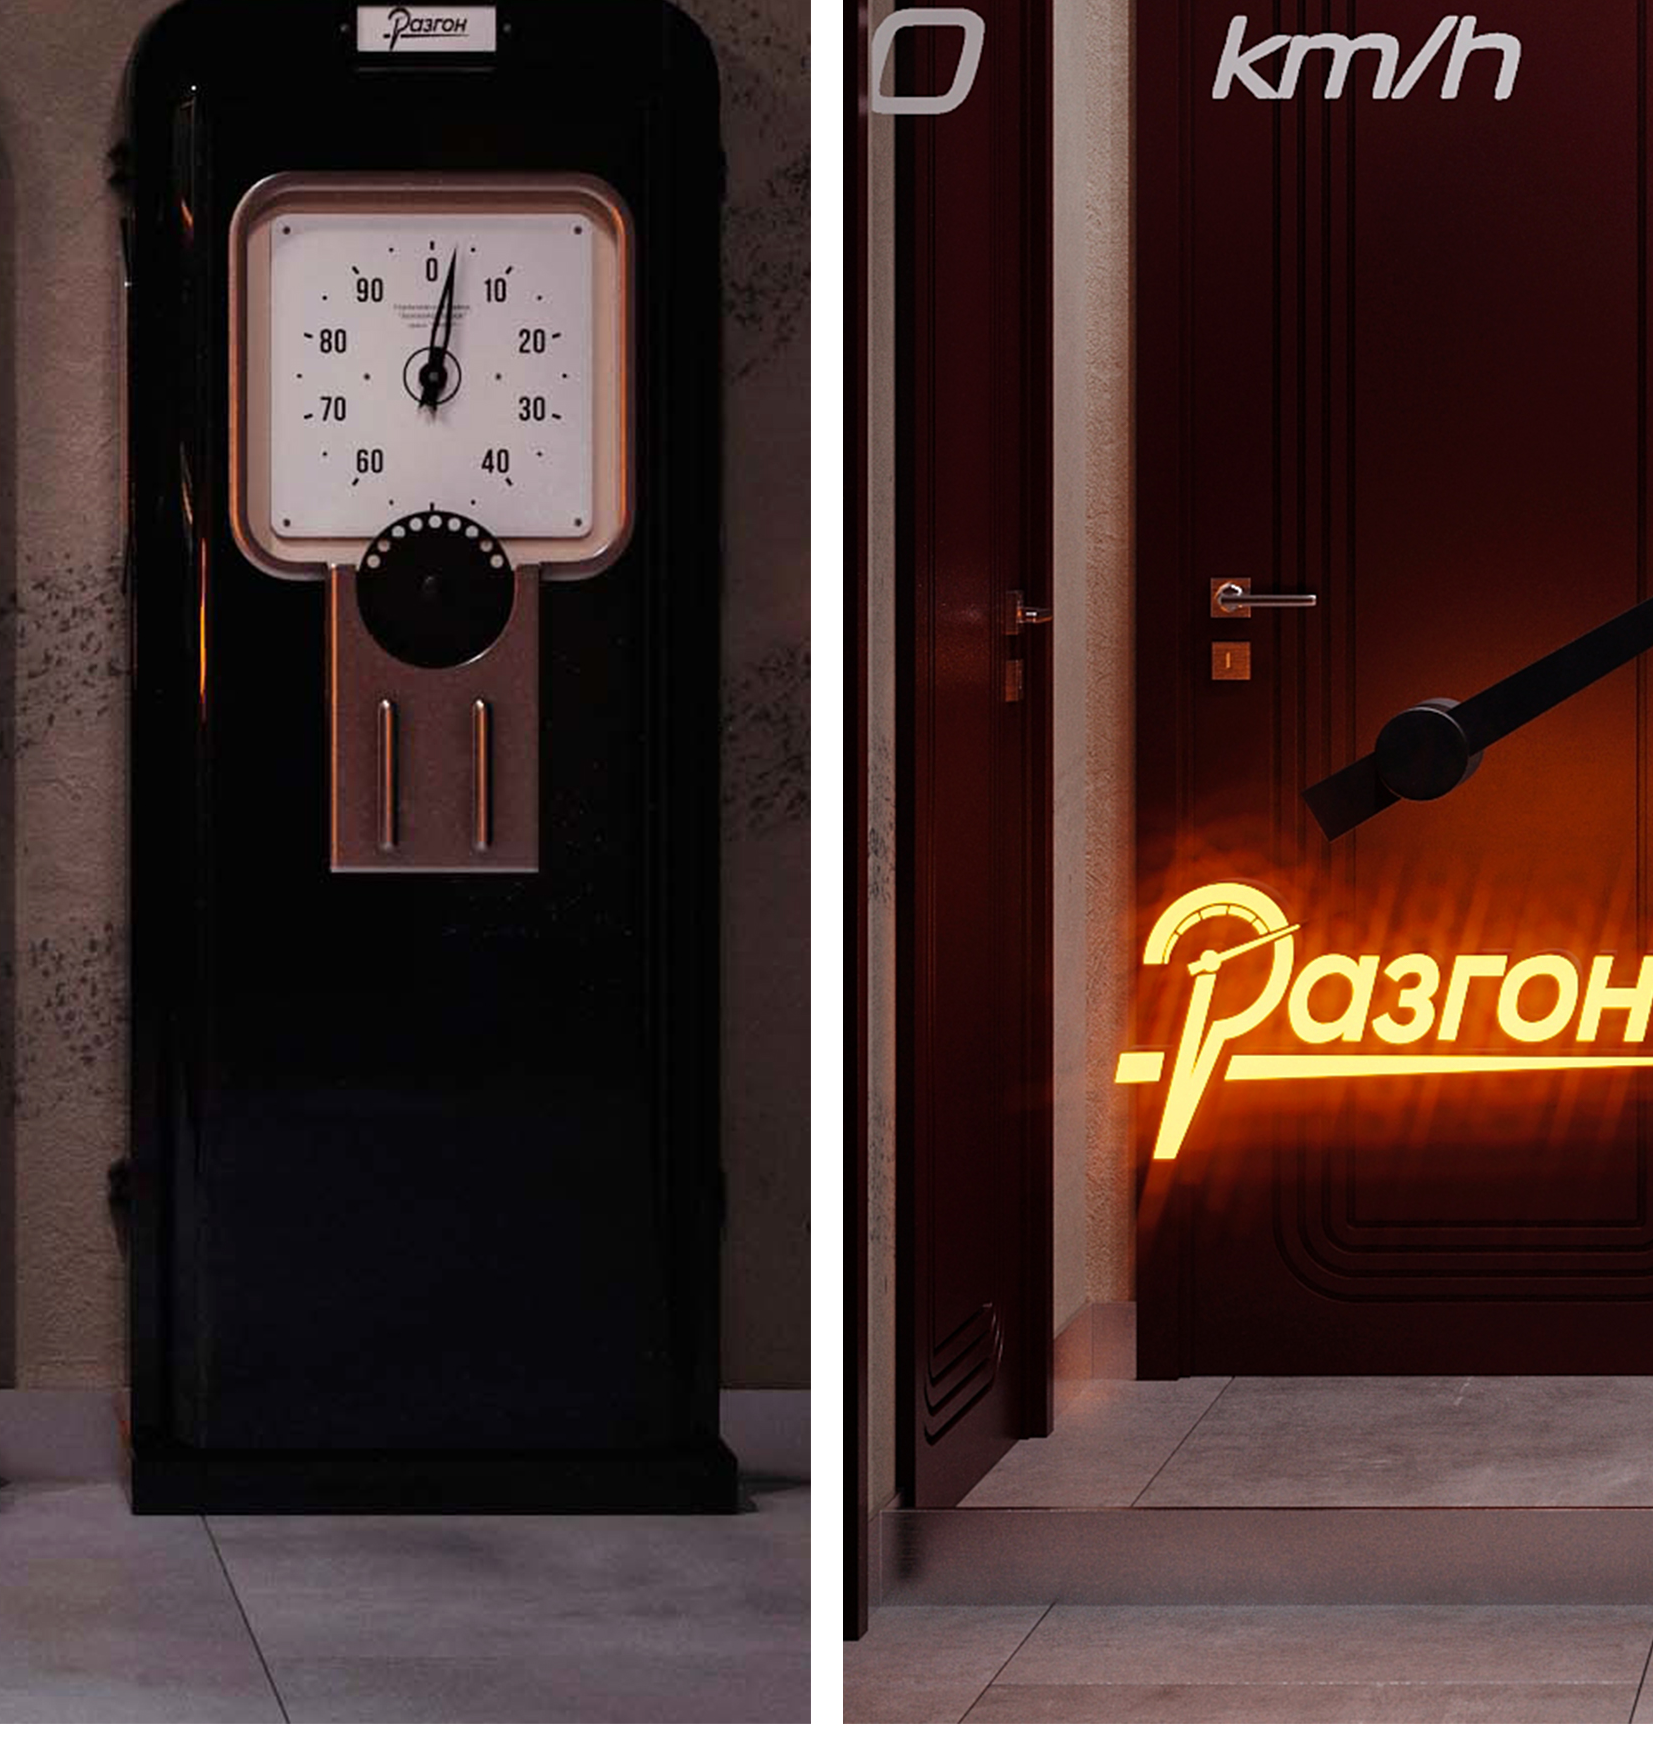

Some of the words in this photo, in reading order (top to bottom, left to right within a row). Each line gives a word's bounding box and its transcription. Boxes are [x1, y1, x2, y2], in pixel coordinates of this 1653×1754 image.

[388, 7, 467, 51] Разгон
[1212, 15, 1521, 100] km/h
[425, 257, 439, 282] 0
[356, 277, 384, 303] 90
[484, 277, 507, 303] 10
[319, 328, 347, 354] 80
[518, 328, 546, 354] 20
[320, 396, 346, 422] 70
[518, 396, 546, 422] 30
[356, 448, 384, 474] 60
[481, 448, 510, 474] 40
